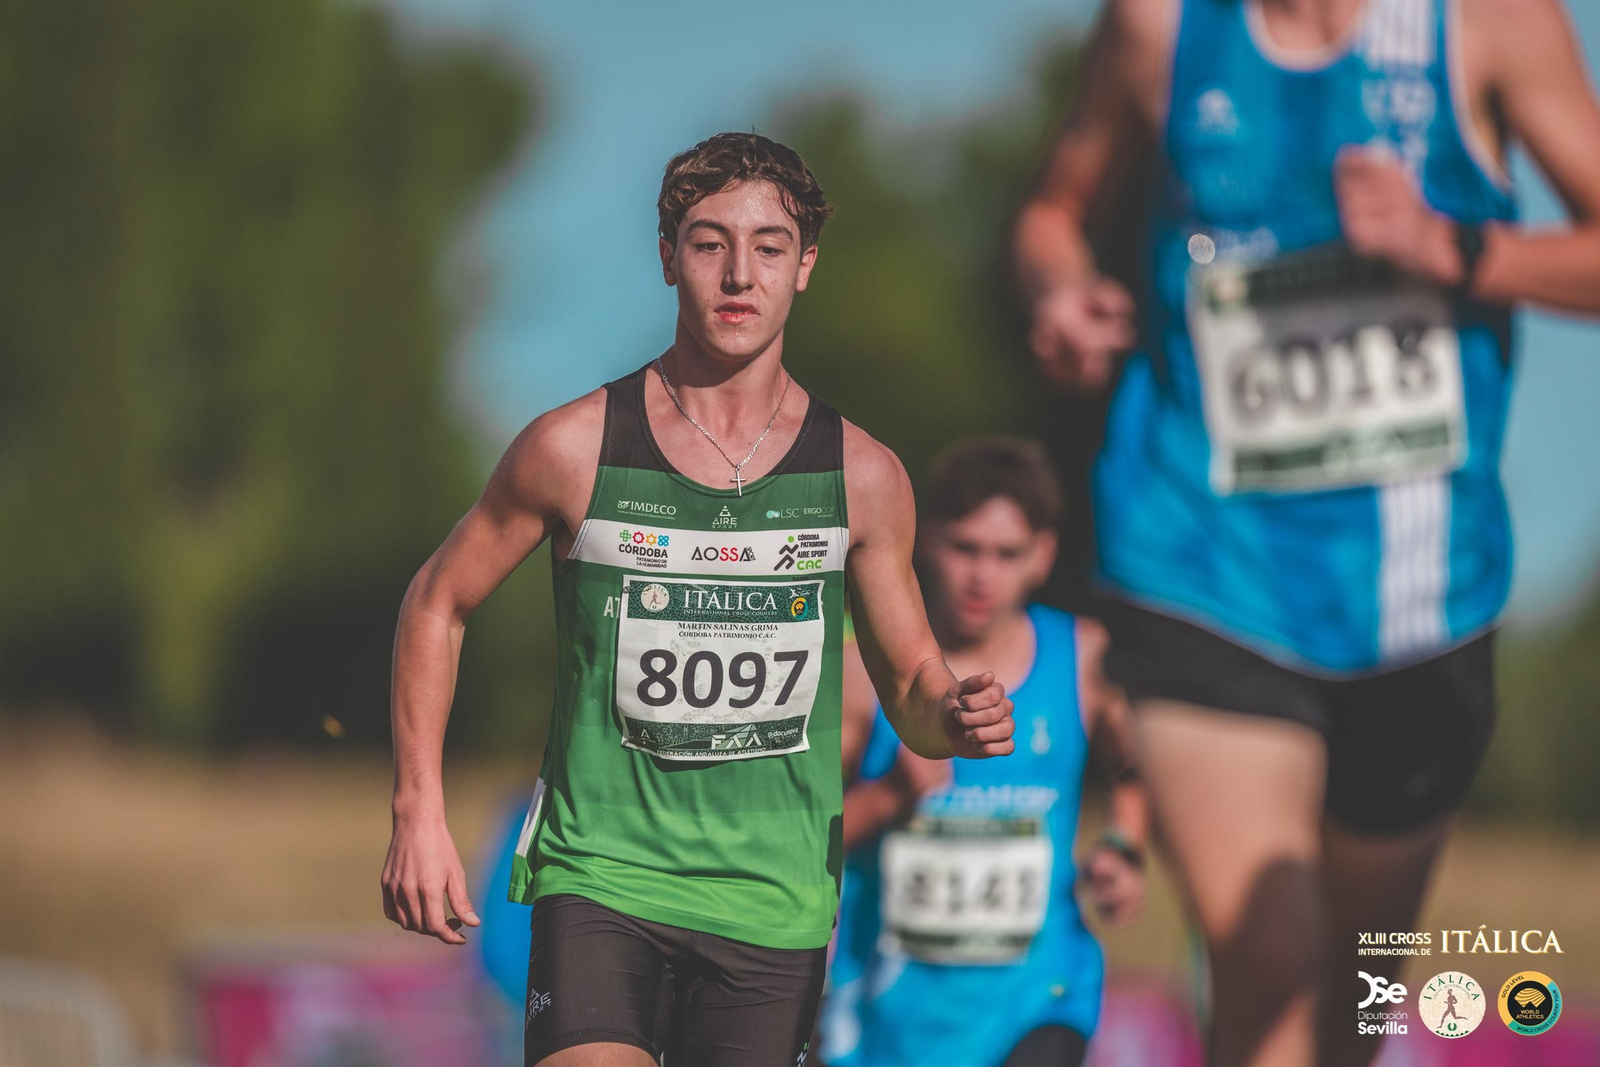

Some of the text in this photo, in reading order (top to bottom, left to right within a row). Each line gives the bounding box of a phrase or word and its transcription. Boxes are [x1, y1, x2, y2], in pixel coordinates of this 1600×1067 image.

[630, 501, 676, 515] IMDECO
[780, 508, 800, 518] LSC
[619, 543, 668, 558] CÓRDOBA
[691, 546, 751, 562] AOSSA
[797, 559, 822, 570] CAC
[684, 586, 777, 610] ITÁLICA
[637, 649, 808, 708] 8097
